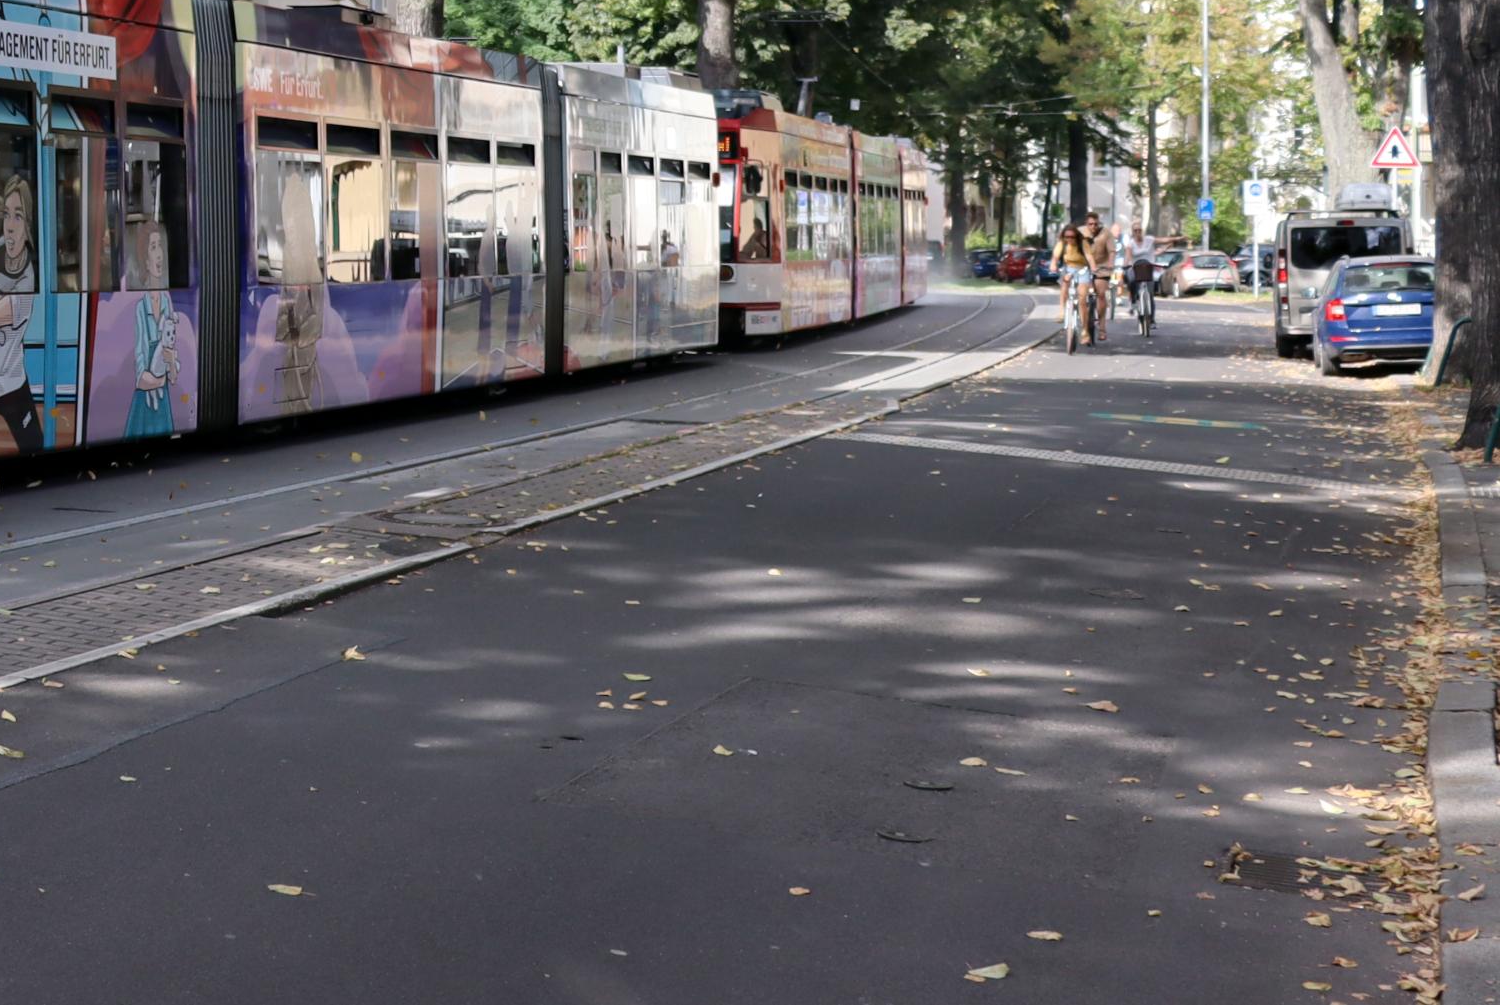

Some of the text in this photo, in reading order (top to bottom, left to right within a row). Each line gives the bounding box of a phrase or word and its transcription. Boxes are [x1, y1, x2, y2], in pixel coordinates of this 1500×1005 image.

[52, 34, 72, 64] FÜR
[73, 43, 112, 71] ERFURT.
[280, 71, 294, 95] Für
